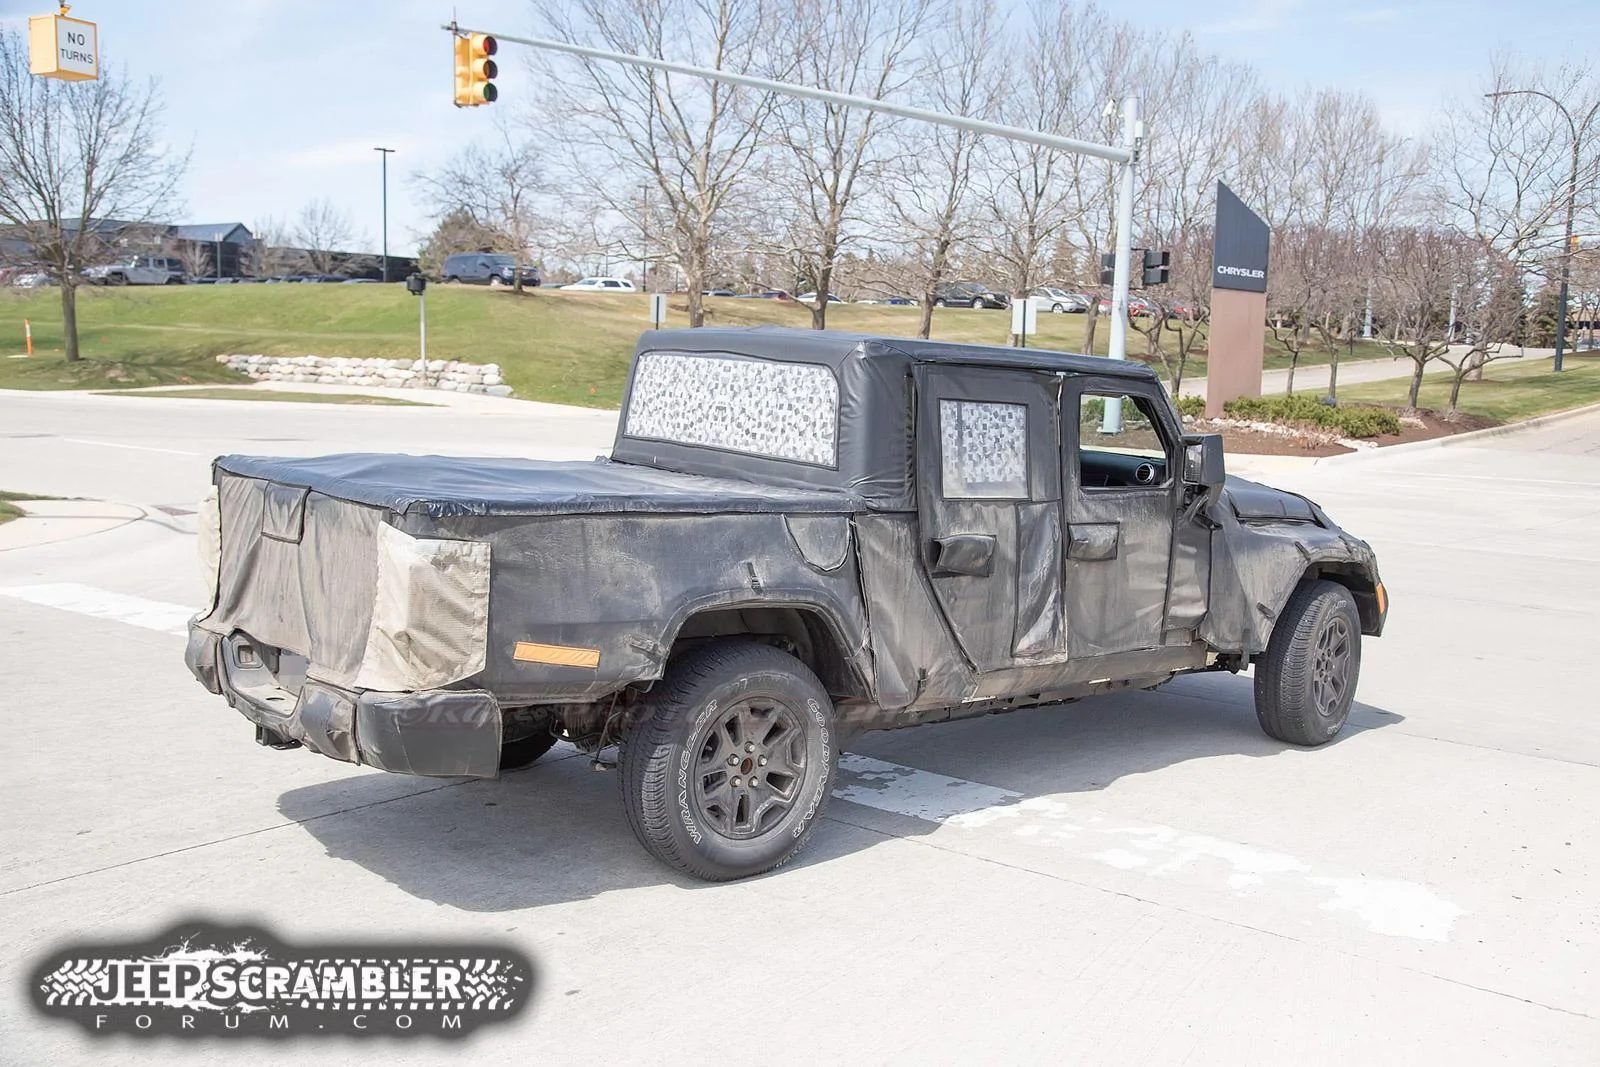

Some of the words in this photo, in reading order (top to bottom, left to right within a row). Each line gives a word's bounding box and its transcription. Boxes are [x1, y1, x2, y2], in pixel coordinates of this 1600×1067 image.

[67, 31, 86, 46] NO
[60, 48, 94, 64] TURNS
[1217, 265, 1265, 279] CHRYSLER
[678, 699, 718, 844] WRANGLER
[793, 698, 830, 838] GOODYEAR
